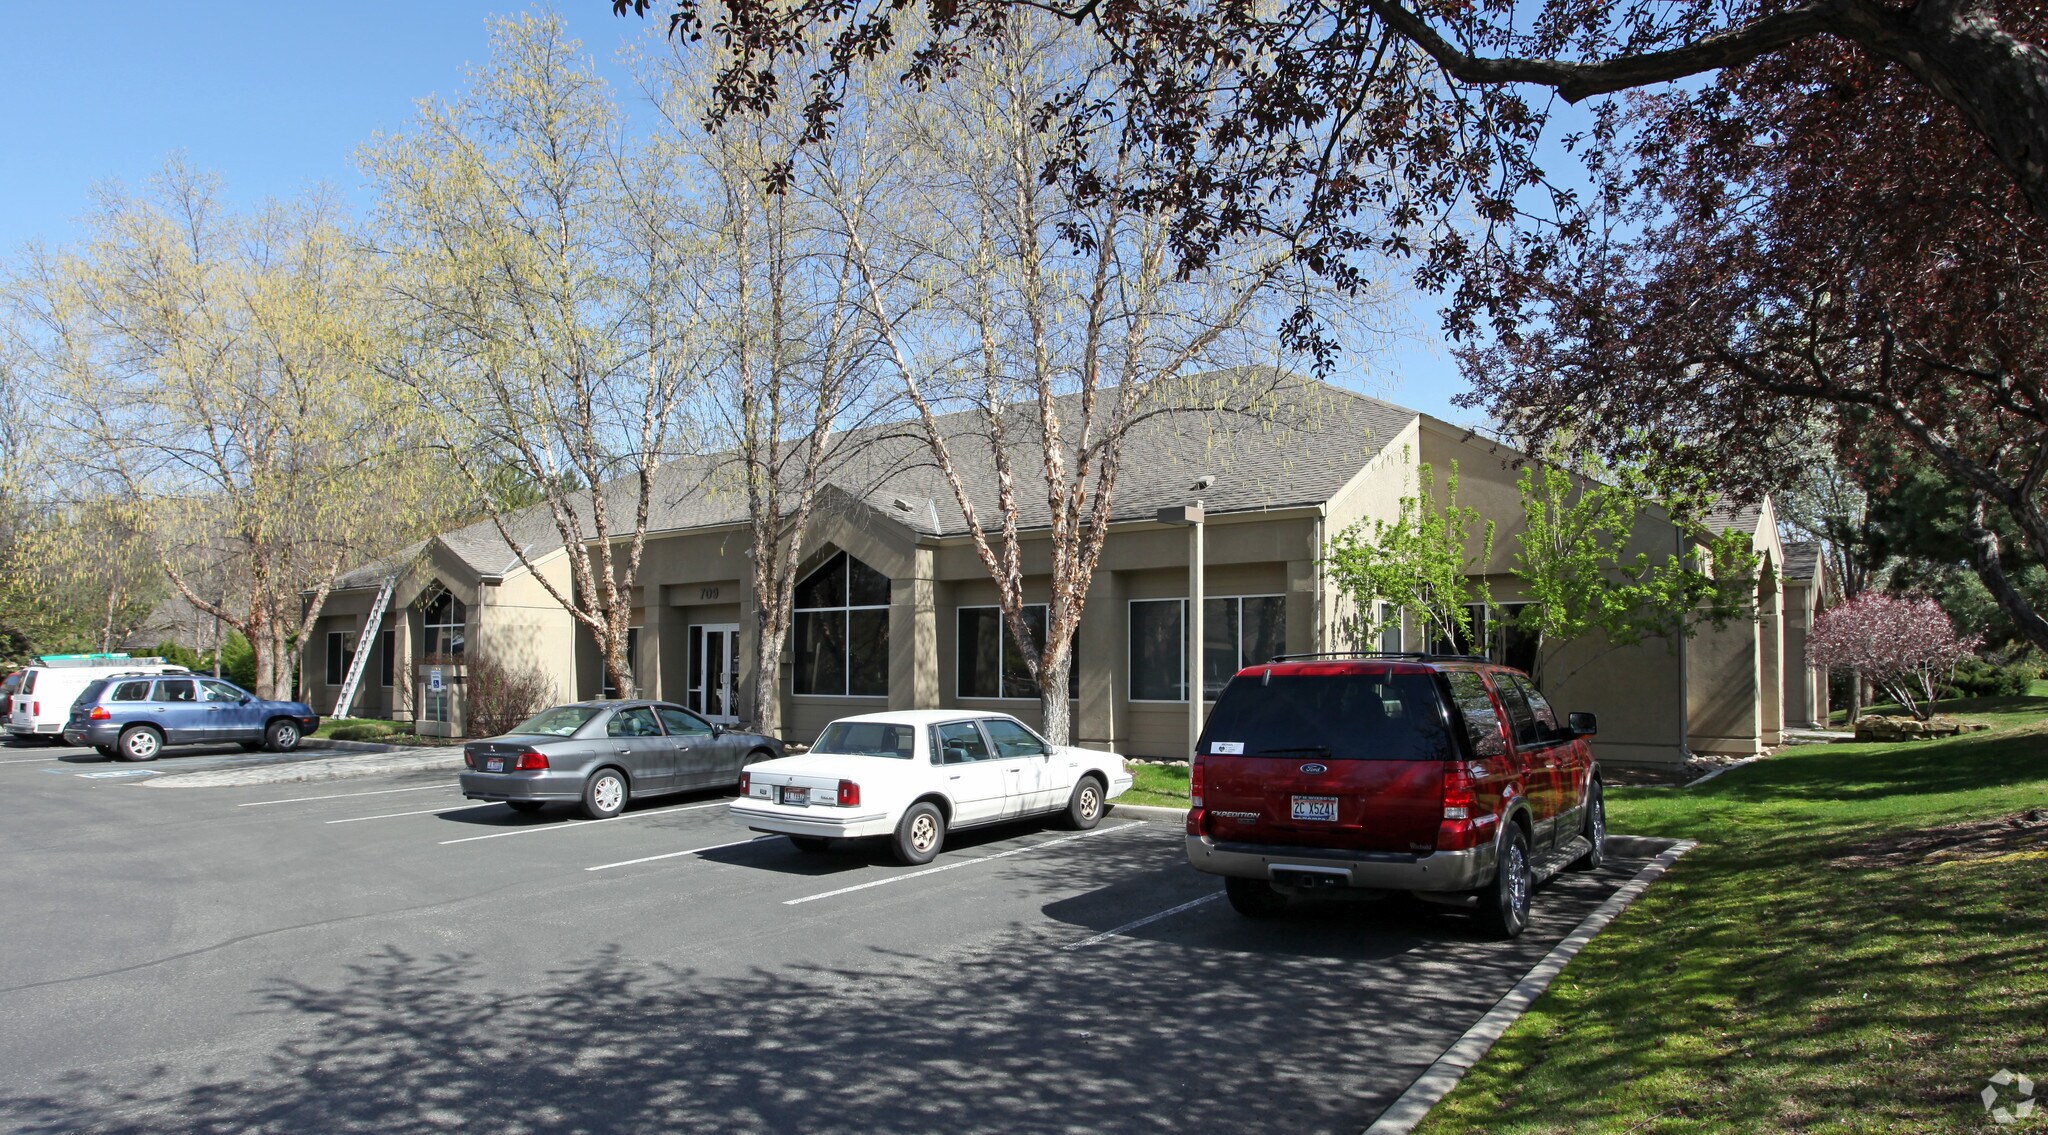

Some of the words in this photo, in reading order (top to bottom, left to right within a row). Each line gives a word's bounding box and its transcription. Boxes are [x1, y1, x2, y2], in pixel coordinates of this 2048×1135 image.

[701, 587, 719, 600] 709
[1211, 810, 1261, 818] EXPEDITION
[1294, 802, 1305, 815] 2C
[1309, 802, 1335, 816] X5241
